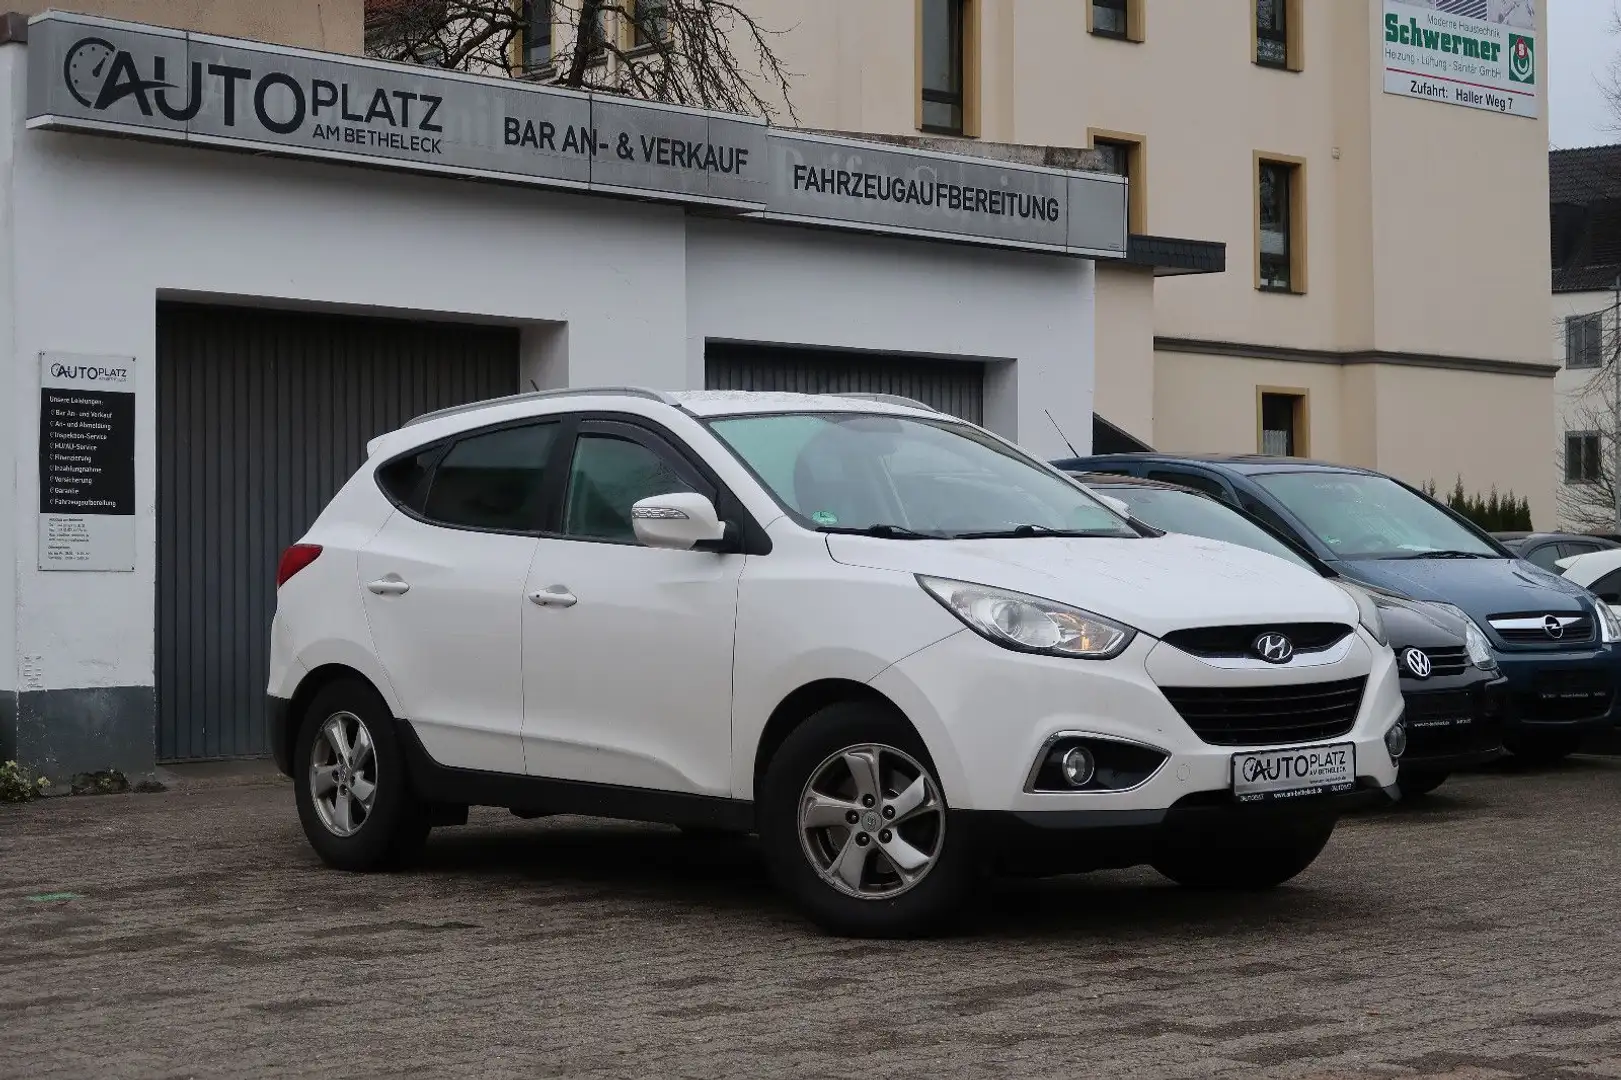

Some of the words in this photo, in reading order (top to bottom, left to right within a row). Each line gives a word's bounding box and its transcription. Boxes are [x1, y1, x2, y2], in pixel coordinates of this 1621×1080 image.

[1384, 13, 1501, 62] Schwermer
[1427, 14, 1457, 29] Moderne
[1458, 22, 1501, 38] Haustechnik
[1384, 47, 1415, 65] Heizung
[1479, 66, 1502, 79] GmbH
[1410, 80, 1449, 99] Zufahrt:
[1455, 88, 1484, 105] Haller
[1485, 94, 1506, 111] Weg
[1508, 98, 1514, 110] 7
[312, 123, 341, 141] AM
[343, 128, 442, 154] BETHELECK
[504, 116, 556, 151] BAR
[561, 124, 609, 157] AN-
[616, 131, 635, 161] &
[640, 134, 750, 175] VERKAUF
[793, 164, 1060, 222] FAHRZEUGAUFBEREITUNG
